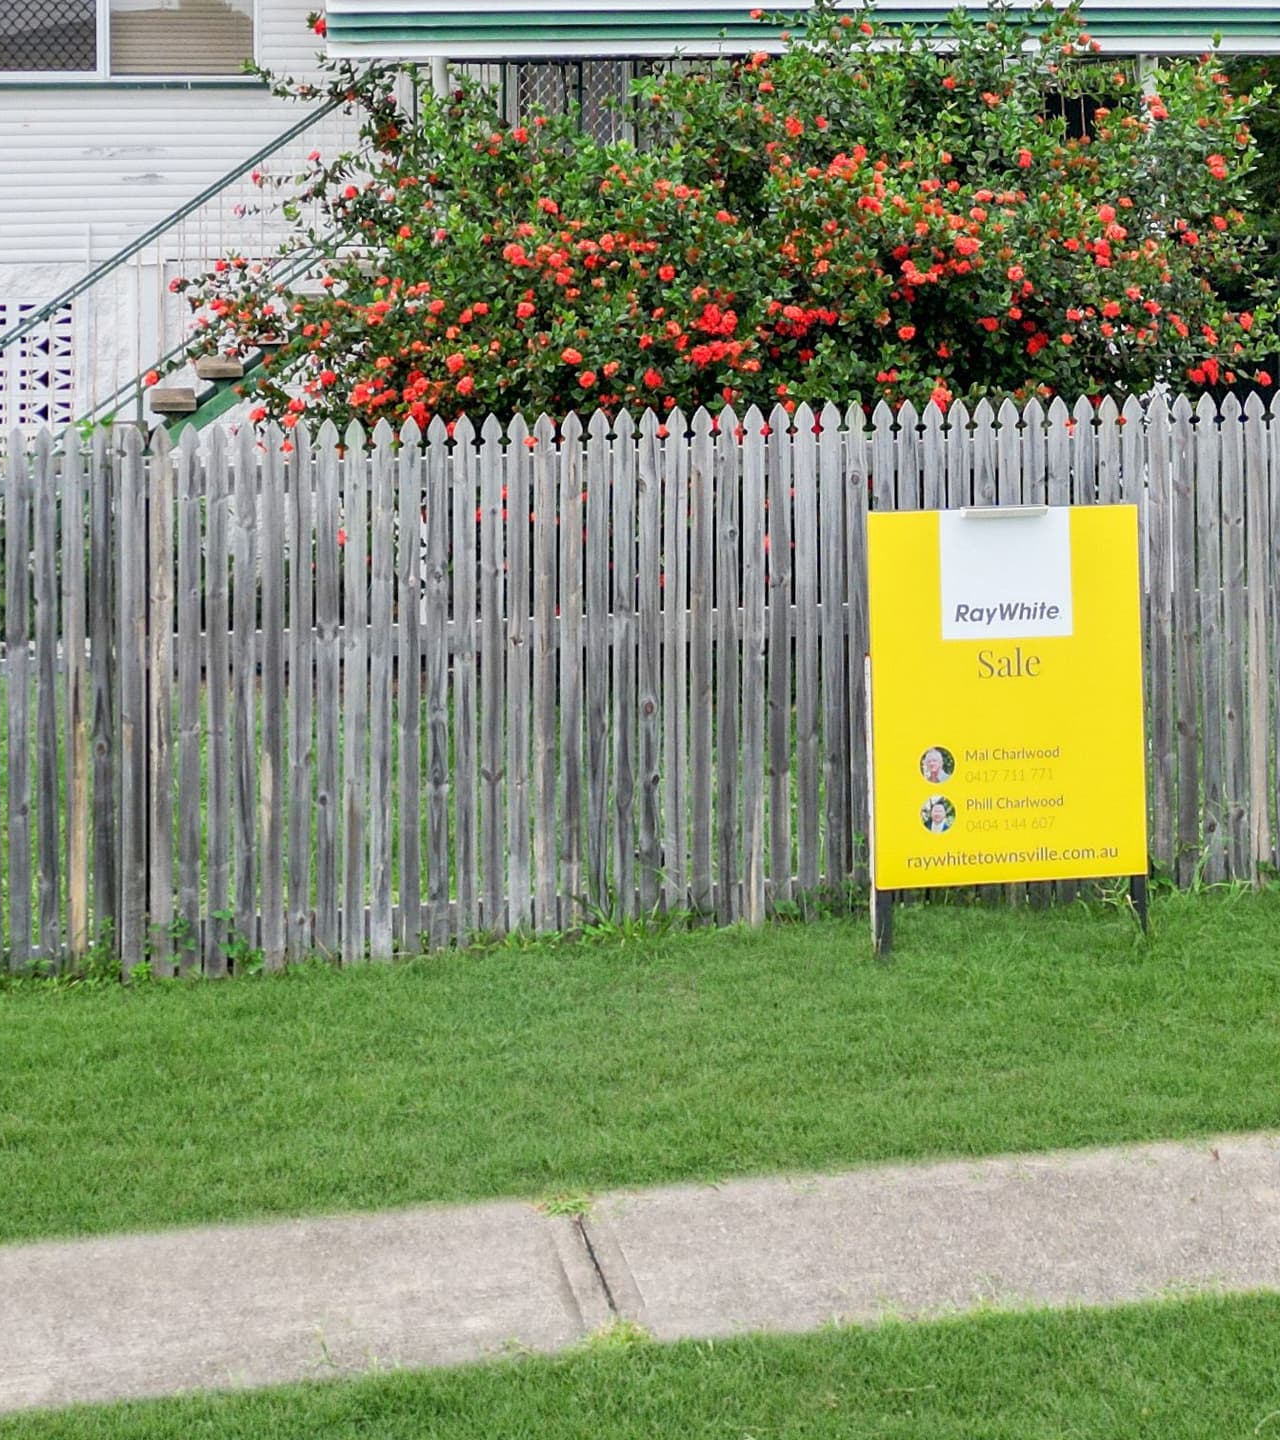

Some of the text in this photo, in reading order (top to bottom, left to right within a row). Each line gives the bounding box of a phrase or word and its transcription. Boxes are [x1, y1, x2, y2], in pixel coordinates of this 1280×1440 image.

[977, 646, 1041, 679] Sale
[965, 745, 1060, 762] Mal Charlwood
[966, 794, 1064, 811] Phill Charlwood
[907, 846, 1119, 870] raywhitetownsville.com.au
